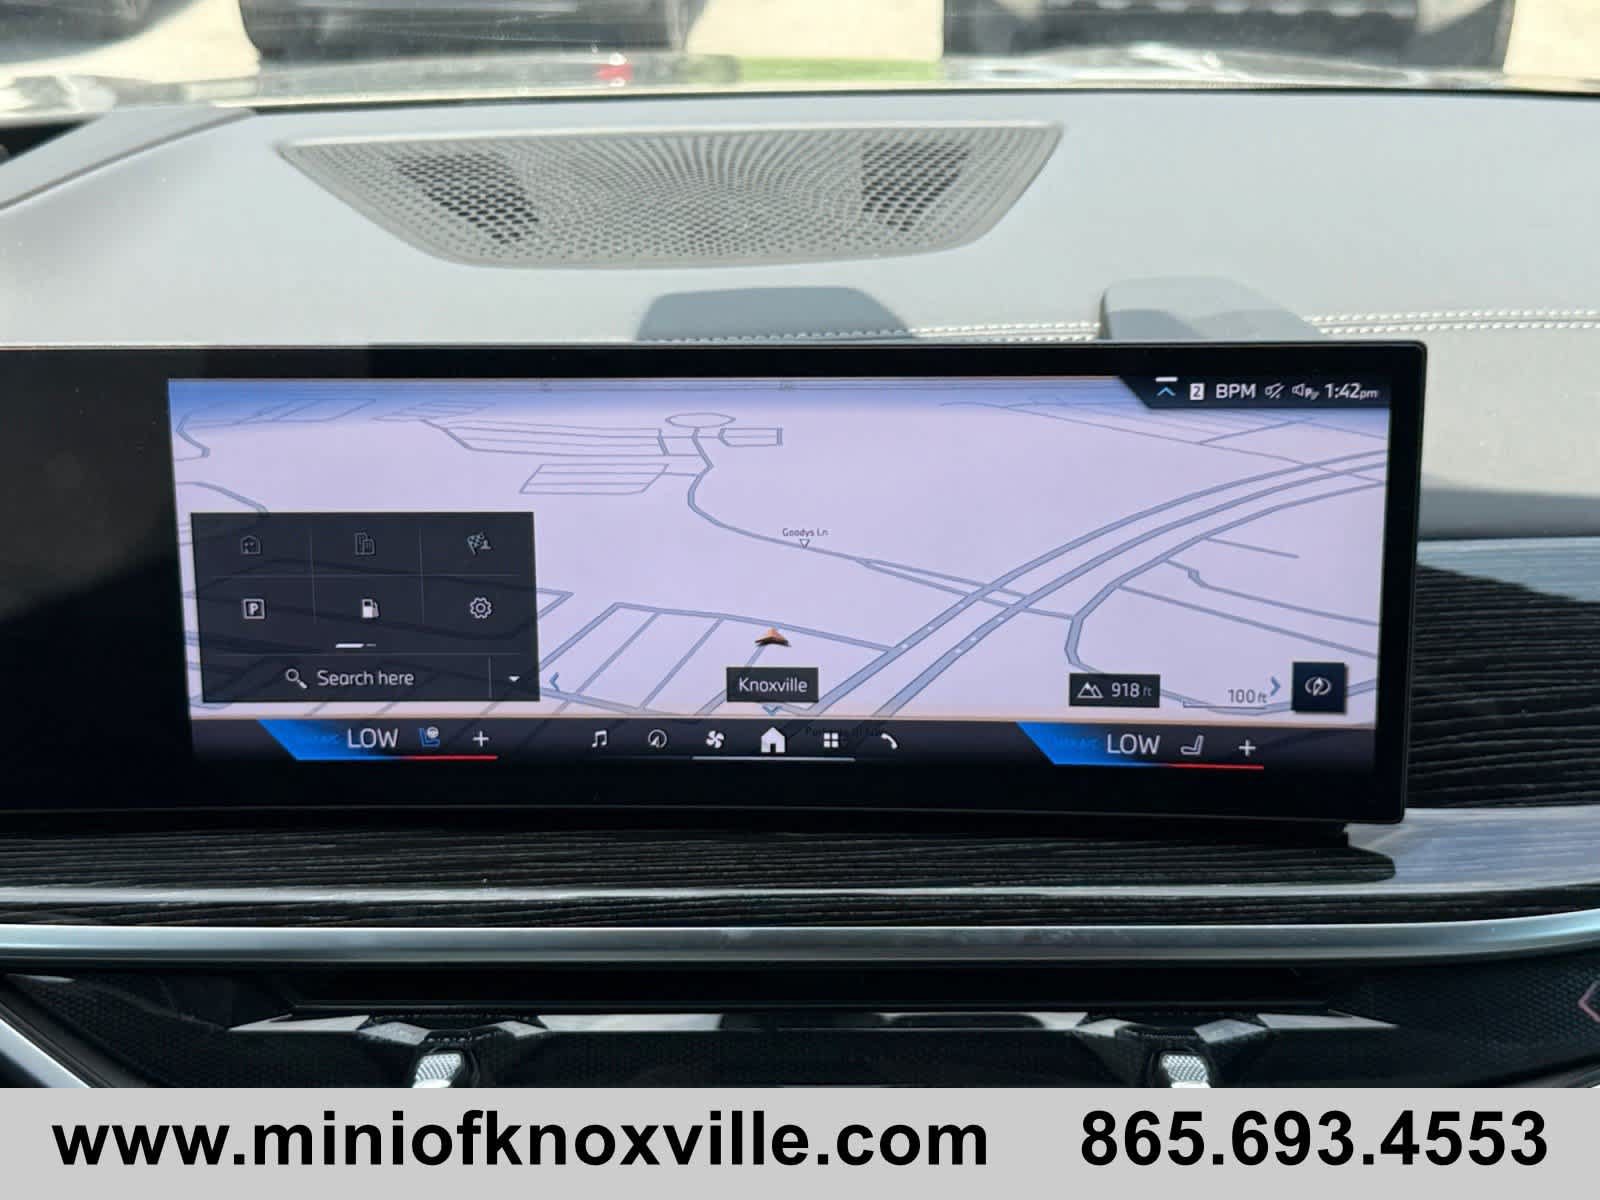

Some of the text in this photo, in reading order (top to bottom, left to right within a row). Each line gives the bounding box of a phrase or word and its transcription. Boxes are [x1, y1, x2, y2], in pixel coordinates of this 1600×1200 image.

[1216, 384, 1256, 399] BPM
[1325, 383, 1378, 400] 1:42pm
[782, 528, 829, 538] Goodys Ln
[318, 669, 415, 687] Search here
[738, 677, 808, 693] Knoxville
[1111, 683, 1140, 698] 918
[347, 728, 399, 749] LOW
[1107, 734, 1161, 756] LOW
